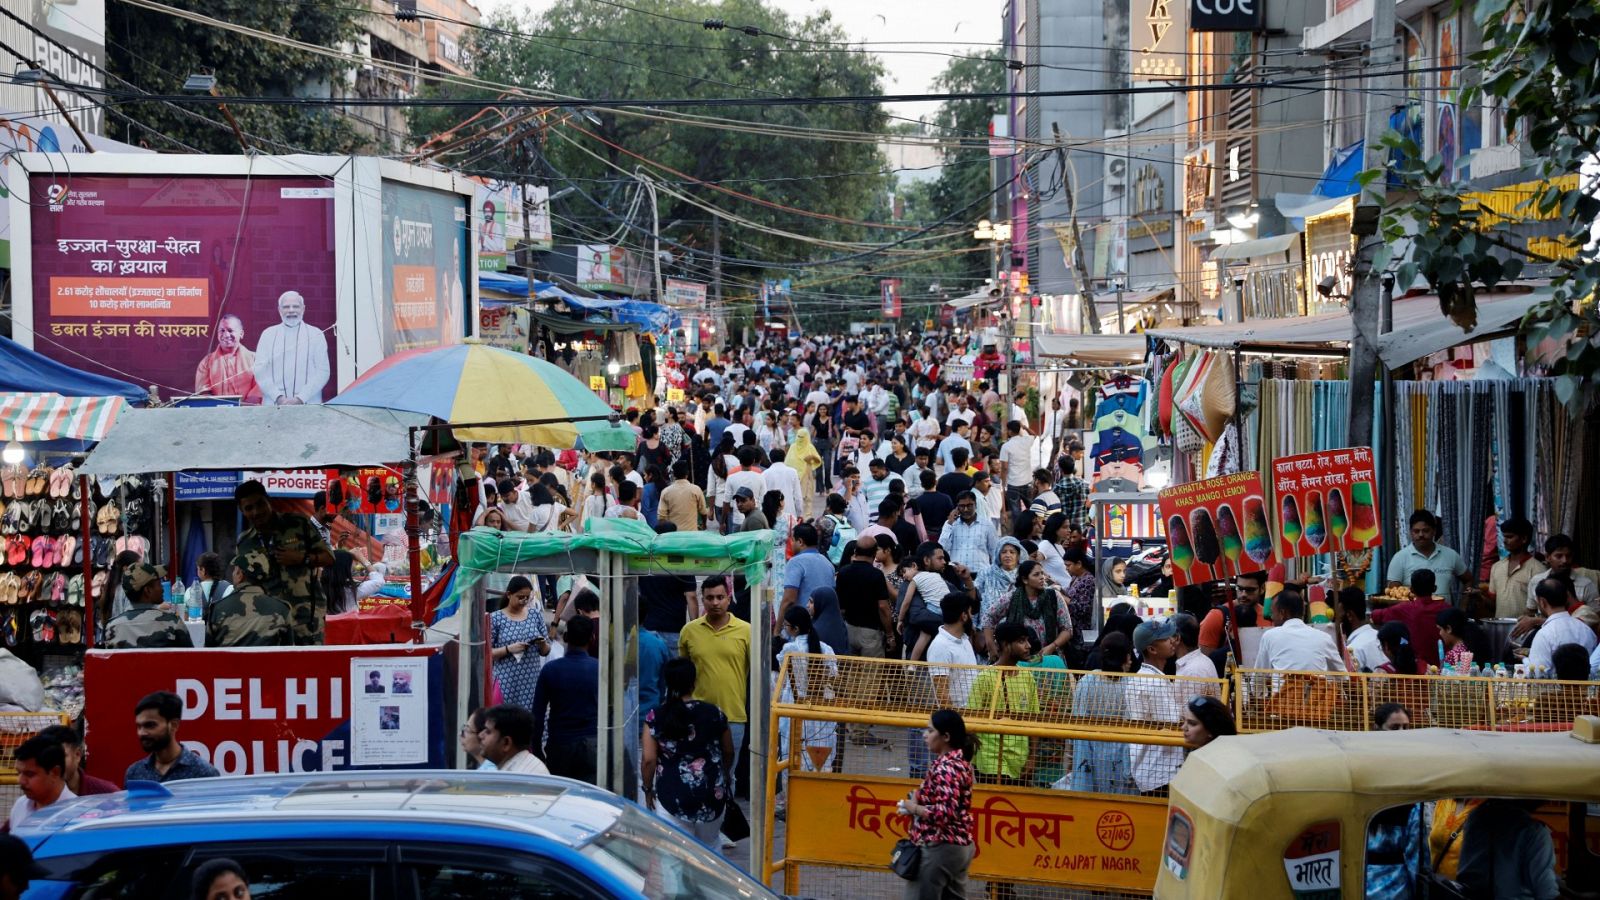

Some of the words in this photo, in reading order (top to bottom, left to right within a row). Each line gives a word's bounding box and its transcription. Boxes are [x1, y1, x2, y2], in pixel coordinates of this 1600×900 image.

[35, 36, 101, 88] BRIDAL
[49, 204, 63, 212] साल
[91, 259, 113, 273] का
[57, 287, 73, 296] 2.61
[74, 286, 93, 297] करोड़
[166, 287, 176, 297] का
[177, 286, 202, 297] निर्माण
[89, 299, 98, 308] 10
[99, 298, 118, 309] करोड़
[120, 298, 135, 309] लोग
[51, 322, 87, 337] डबल
[91, 320, 130, 338] इंजन
[134, 320, 155, 337] की
[158, 324, 209, 338] सरकार
[1223, 485, 1246, 498] LEMON
[176, 677, 343, 720] DELHI
[1101, 856, 1142, 874] NAGAR
[1294, 858, 1335, 886] भारत
